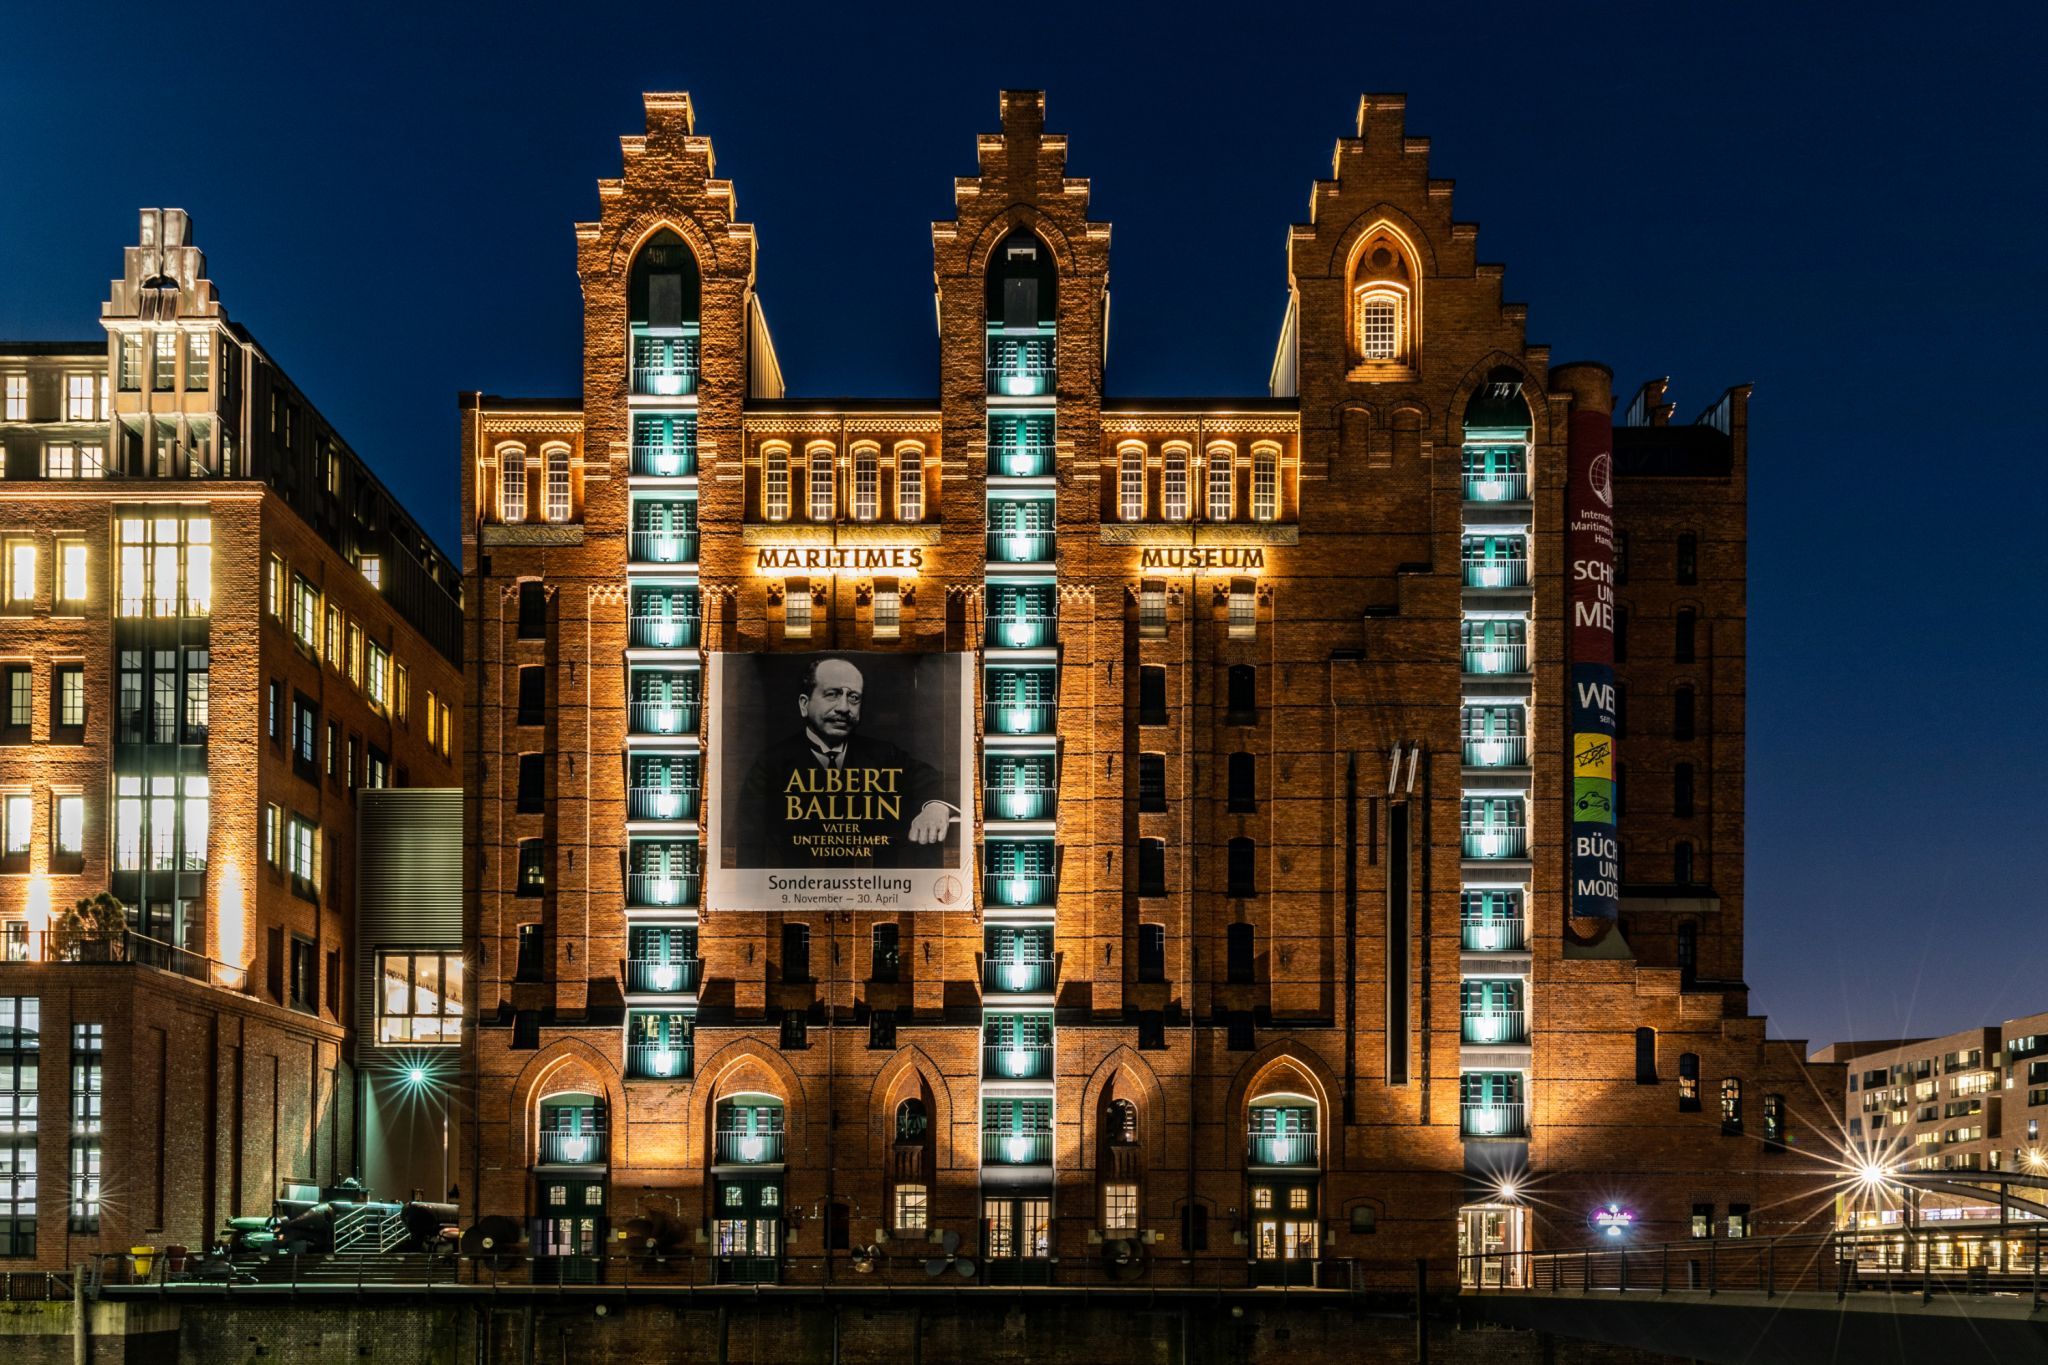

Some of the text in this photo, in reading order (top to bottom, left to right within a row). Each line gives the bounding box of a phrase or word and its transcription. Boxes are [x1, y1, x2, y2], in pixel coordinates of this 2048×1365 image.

[757, 547, 1265, 568] MARITIMES MUSEUM
[783, 768, 903, 793] ALBERT
[785, 795, 902, 821] BALLIN
[822, 823, 860, 833] VATER
[793, 835, 890, 845] UNTERNEHMER
[810, 845, 872, 857] VISIONÄR
[768, 875, 912, 894] Sonderausstellung
[781, 894, 791, 904] 9.
[794, 894, 843, 904] November
[857, 894, 873, 904] 30.
[875, 893, 899, 905] April
